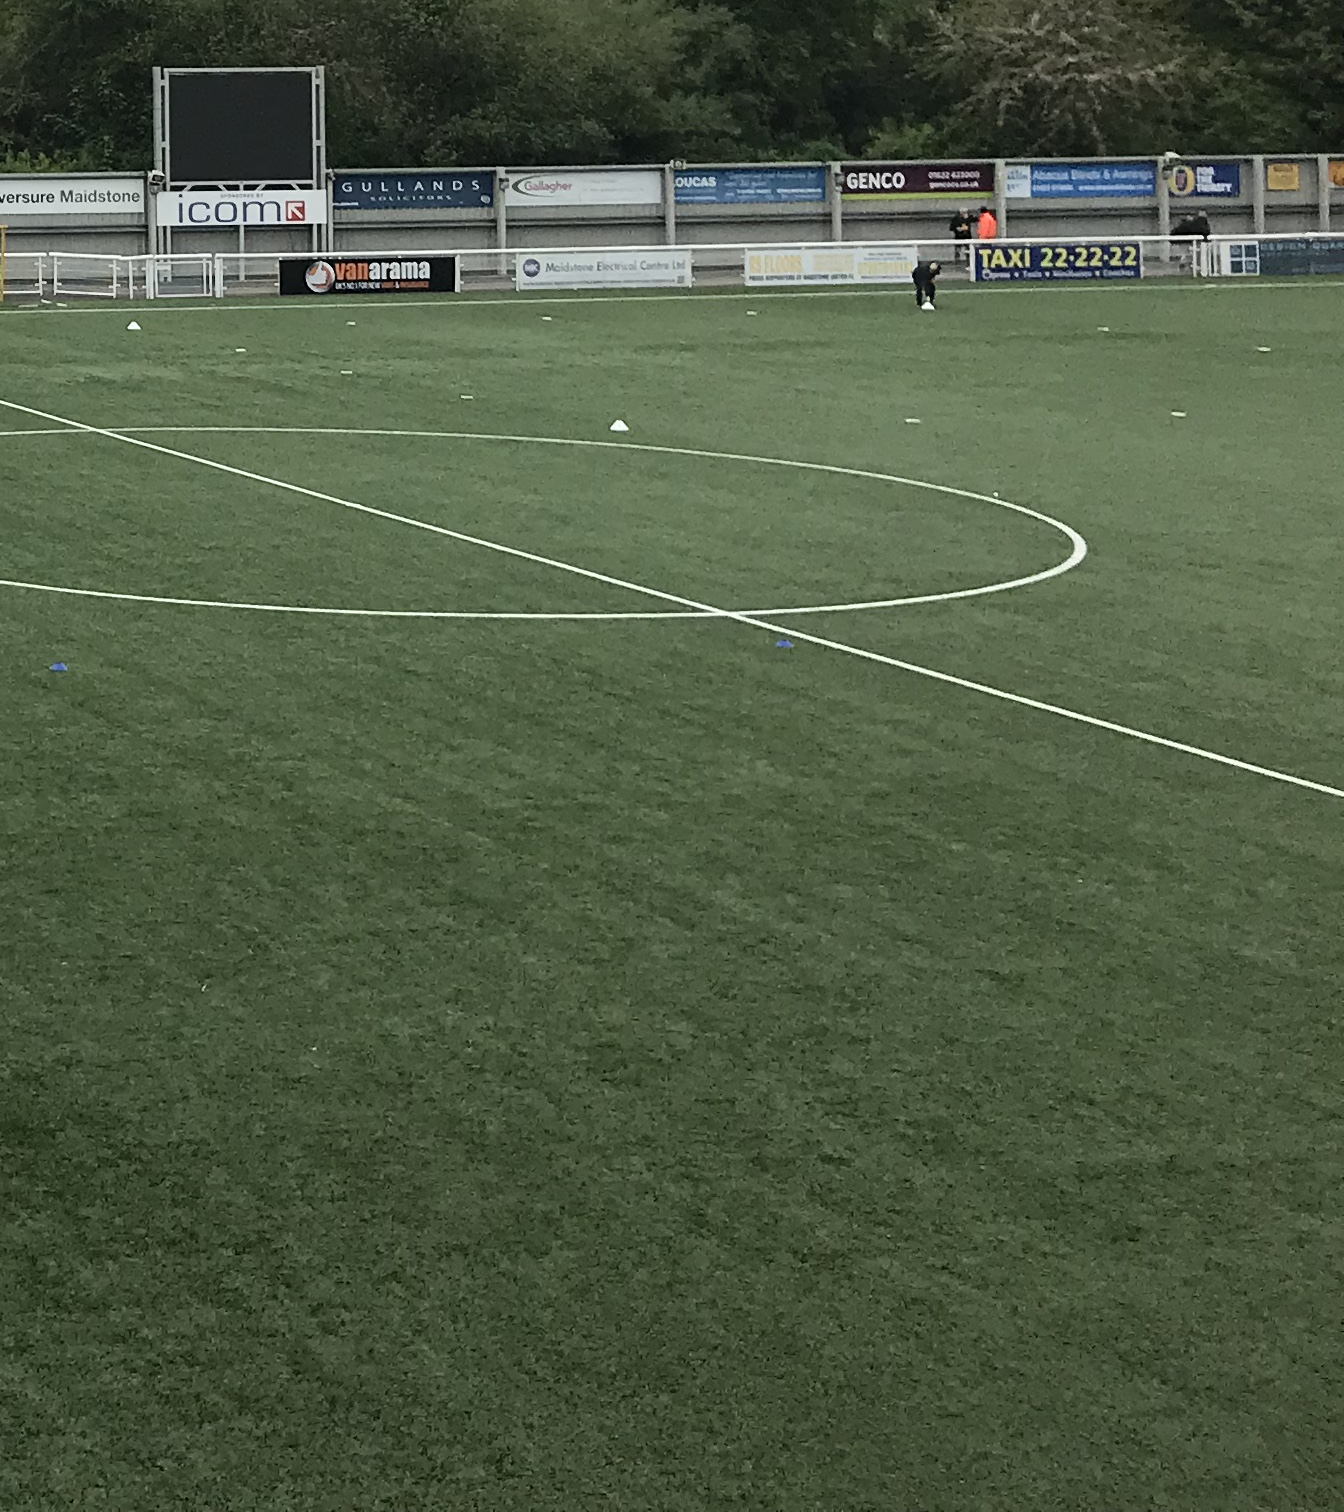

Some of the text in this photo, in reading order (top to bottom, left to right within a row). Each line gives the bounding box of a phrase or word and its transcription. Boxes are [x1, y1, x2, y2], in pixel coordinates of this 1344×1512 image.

[341, 180, 480, 193] GULLANDS
[524, 180, 573, 193] Gallagher
[846, 172, 906, 190] GENCO
[60, 190, 141, 203] Maidstone
[370, 194, 452, 202] SOLICITORS
[978, 248, 1031, 269] TAXI
[334, 261, 431, 281] vanarama
[545, 259, 686, 273] Maidstone Electrical Centre Ltd
